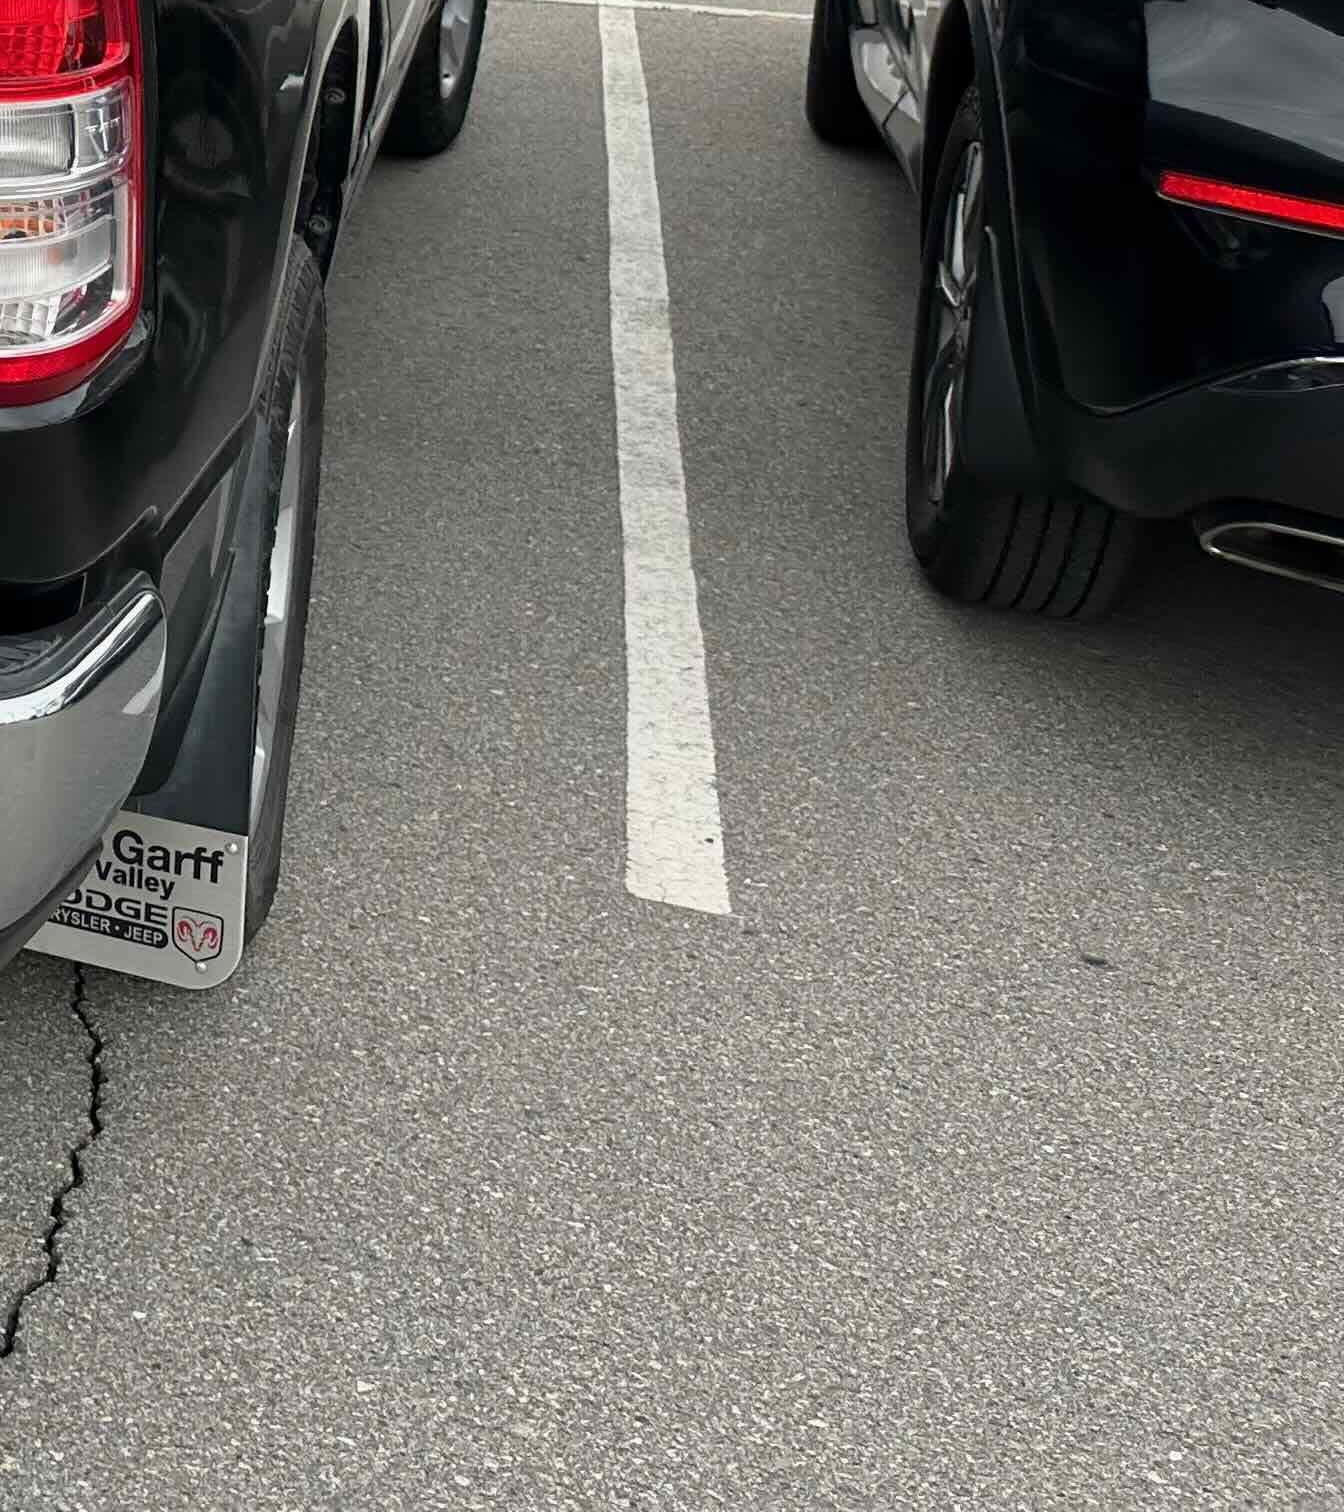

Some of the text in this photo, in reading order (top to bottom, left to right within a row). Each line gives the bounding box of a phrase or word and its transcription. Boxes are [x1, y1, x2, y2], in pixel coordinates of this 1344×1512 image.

[113, 829, 224, 884] Garff
[95, 859, 175, 900] Valley
[50, 907, 163, 945] RYSLER JEEP
